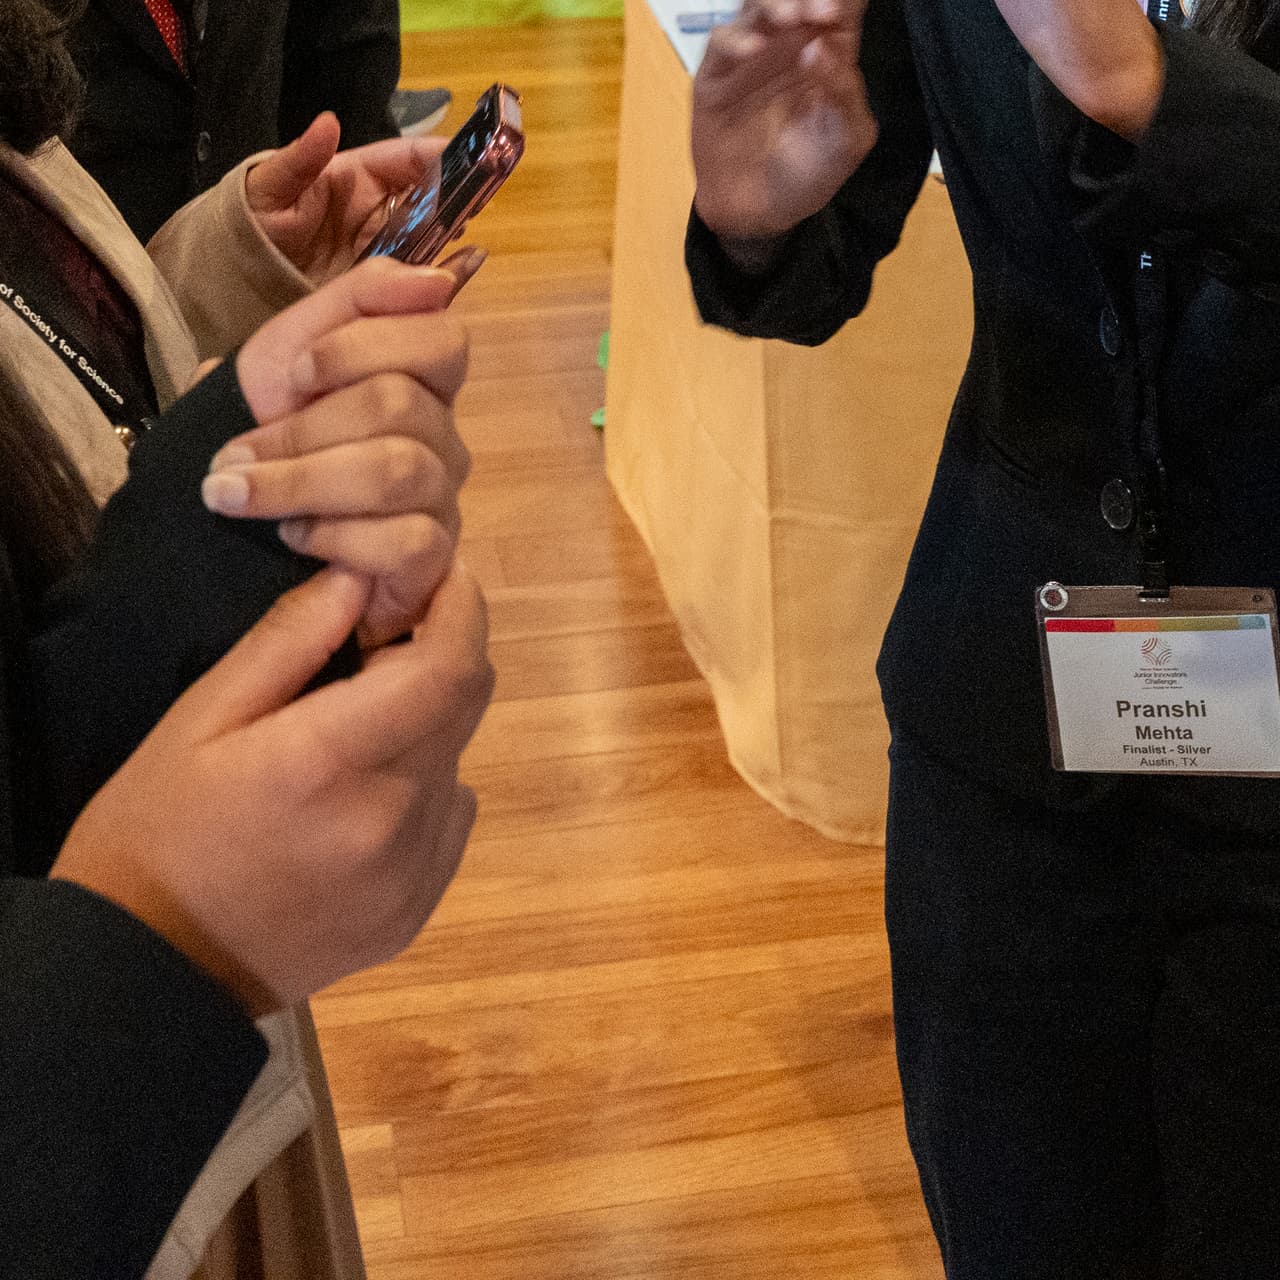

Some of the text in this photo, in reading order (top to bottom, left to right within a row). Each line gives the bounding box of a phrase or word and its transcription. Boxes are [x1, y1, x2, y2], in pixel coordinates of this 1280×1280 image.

[13, 294, 58, 343] Society
[58, 337, 78, 360] for
[77, 355, 125, 406] Science
[1116, 700, 1208, 718] Pranshi
[1135, 725, 1194, 740] Mehta
[1122, 744, 1212, 755] Finalist Silver
[1139, 756, 1199, 768] Austin, TX
